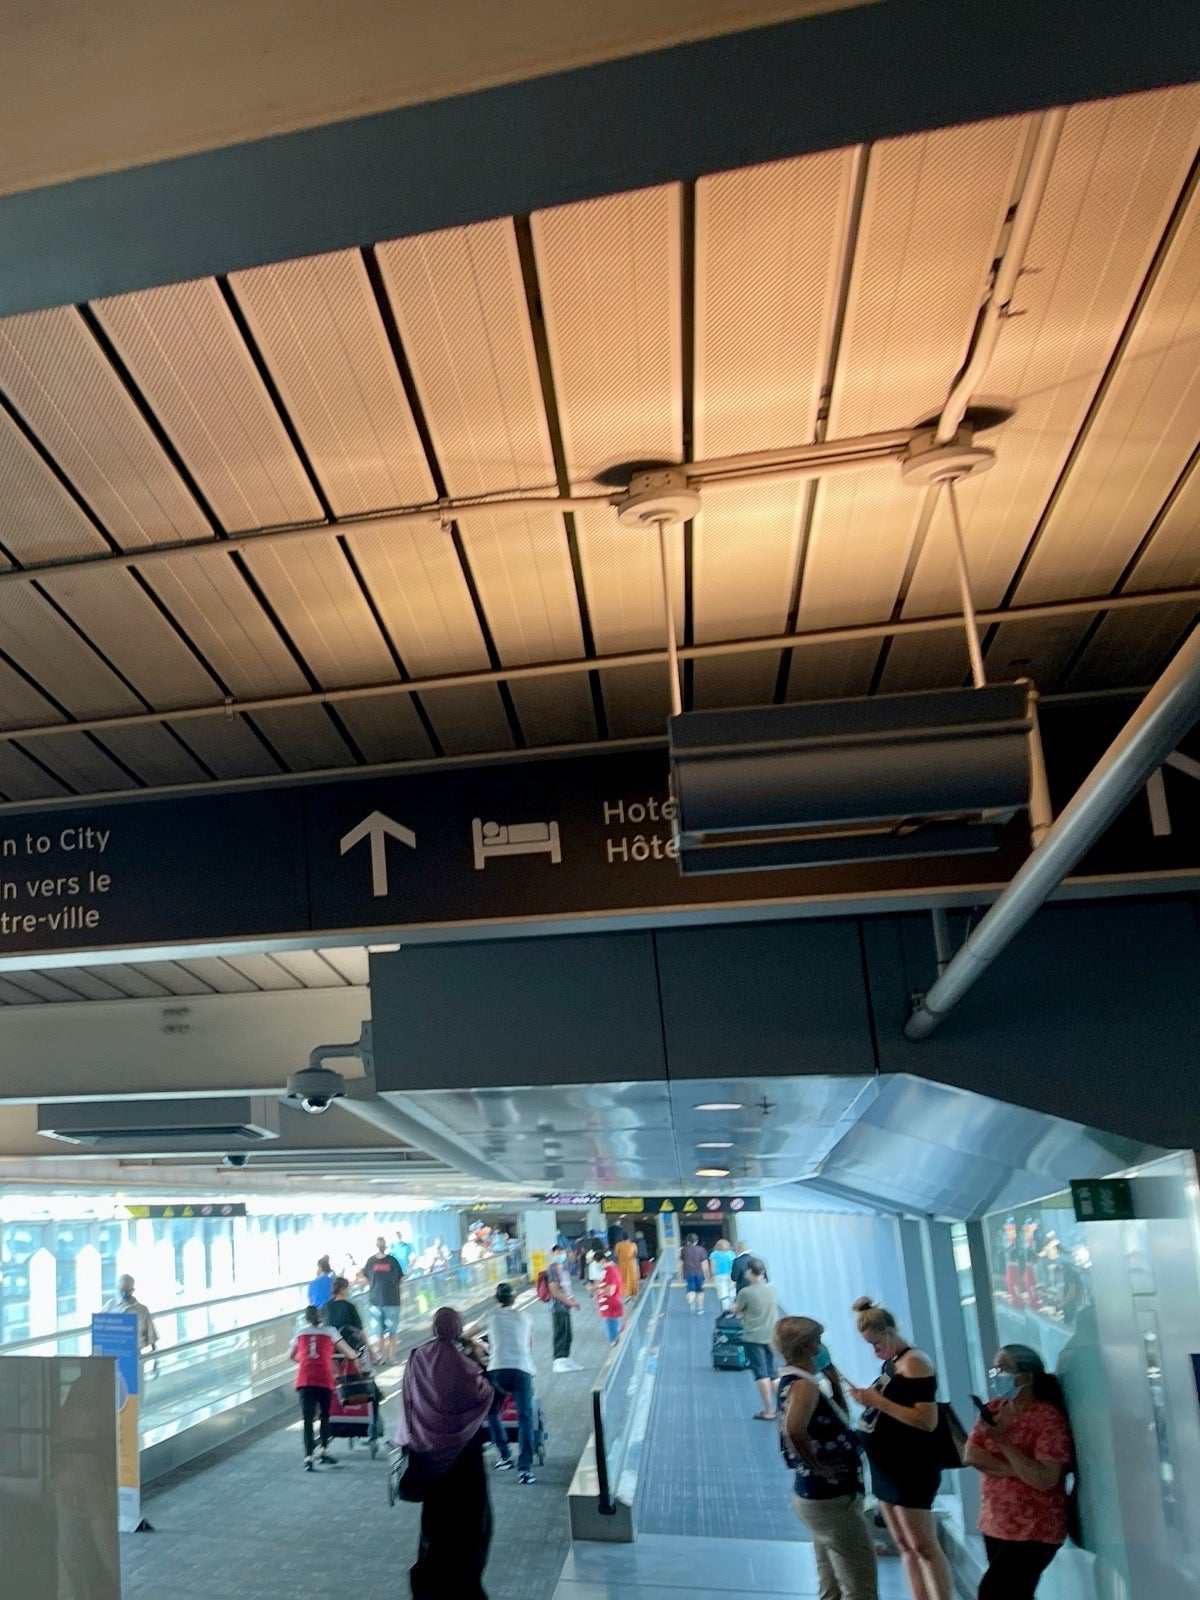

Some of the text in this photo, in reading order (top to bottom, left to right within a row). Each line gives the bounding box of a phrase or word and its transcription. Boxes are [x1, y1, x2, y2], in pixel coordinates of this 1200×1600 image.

[603, 797, 677, 825] Hote
[26, 833, 50, 854] to
[60, 827, 110, 853] City
[607, 834, 680, 863] Hôte
[26, 875, 80, 898] vers
[89, 871, 111, 893] le
